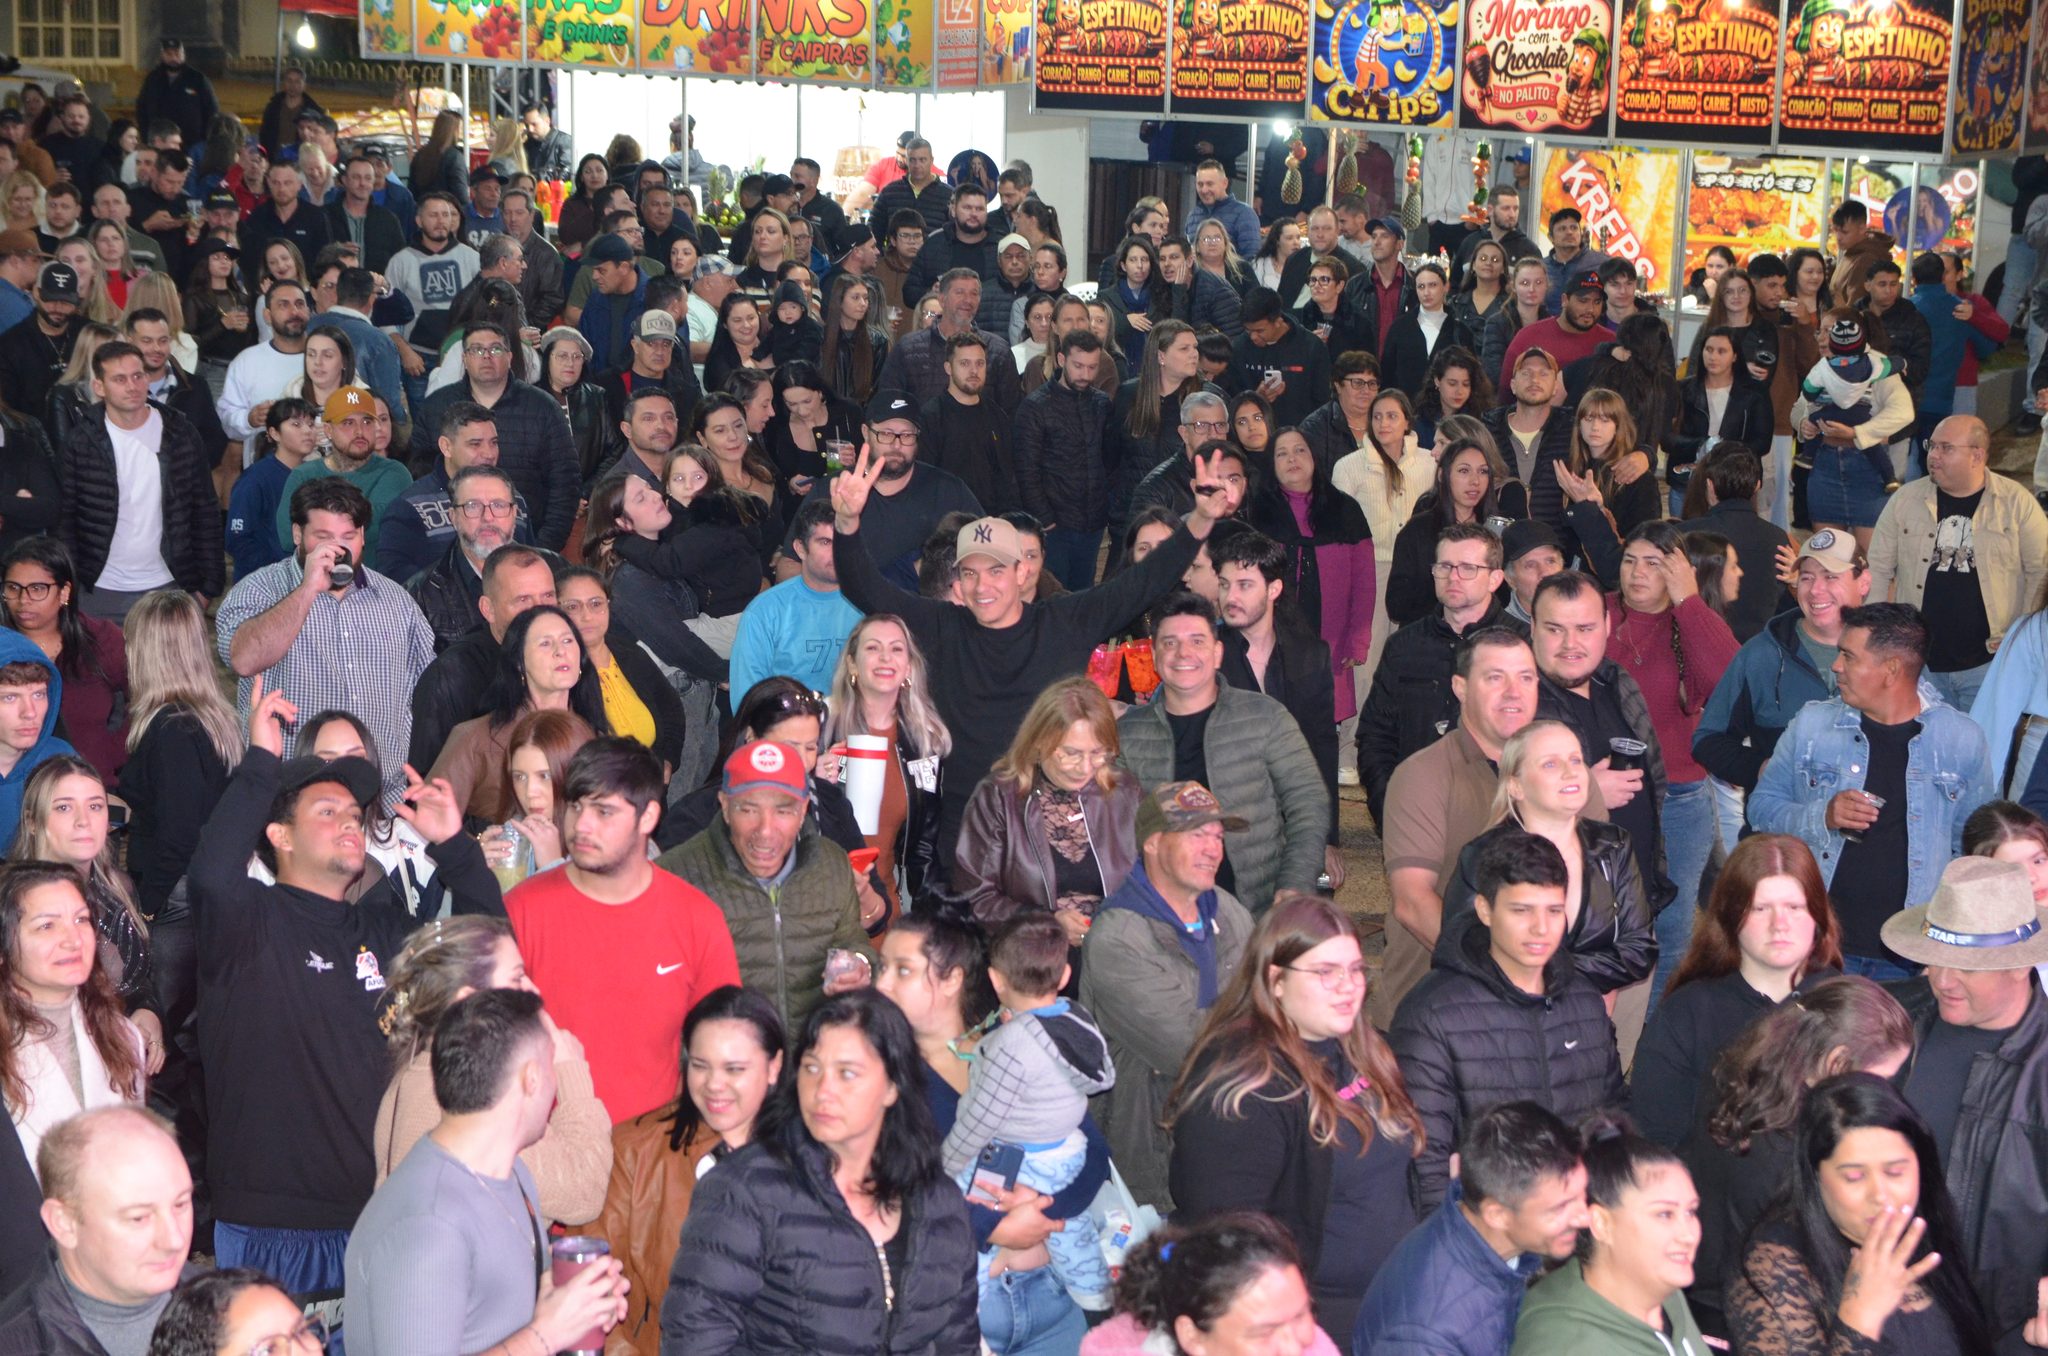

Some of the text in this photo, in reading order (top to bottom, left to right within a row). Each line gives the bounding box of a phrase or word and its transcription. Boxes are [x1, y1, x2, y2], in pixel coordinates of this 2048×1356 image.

[1082, 0, 1161, 36] ESPETINHO
[1220, 0, 1304, 40] ESPETINHO
[1483, 0, 1591, 42] Morango
[543, 20, 628, 46] E DRINKS
[1528, 32, 1550, 44] com
[1677, 21, 1773, 60] ESPETINHO
[760, 40, 868, 65] E CAIPIRAS
[1491, 40, 1569, 74] Chocolate
[1844, 26, 1946, 66] ESPETINHO
[1042, 64, 1159, 85] CORAÇÃO FRANGO CARNE MISTO
[1177, 68, 1300, 90] CORAÇÃO FRANGO CARNE MISTO
[1499, 87, 1550, 103] NO PALITO
[1625, 90, 1768, 113] CORAÇÃO FRANGO CARNE MISTO
[1788, 97, 1939, 121] CORAÇÃO FRANGO CARNE MISTO
[231, 519, 243, 530] RS
[973, 524, 992, 543] NY
[1927, 927, 1956, 944] STAR
